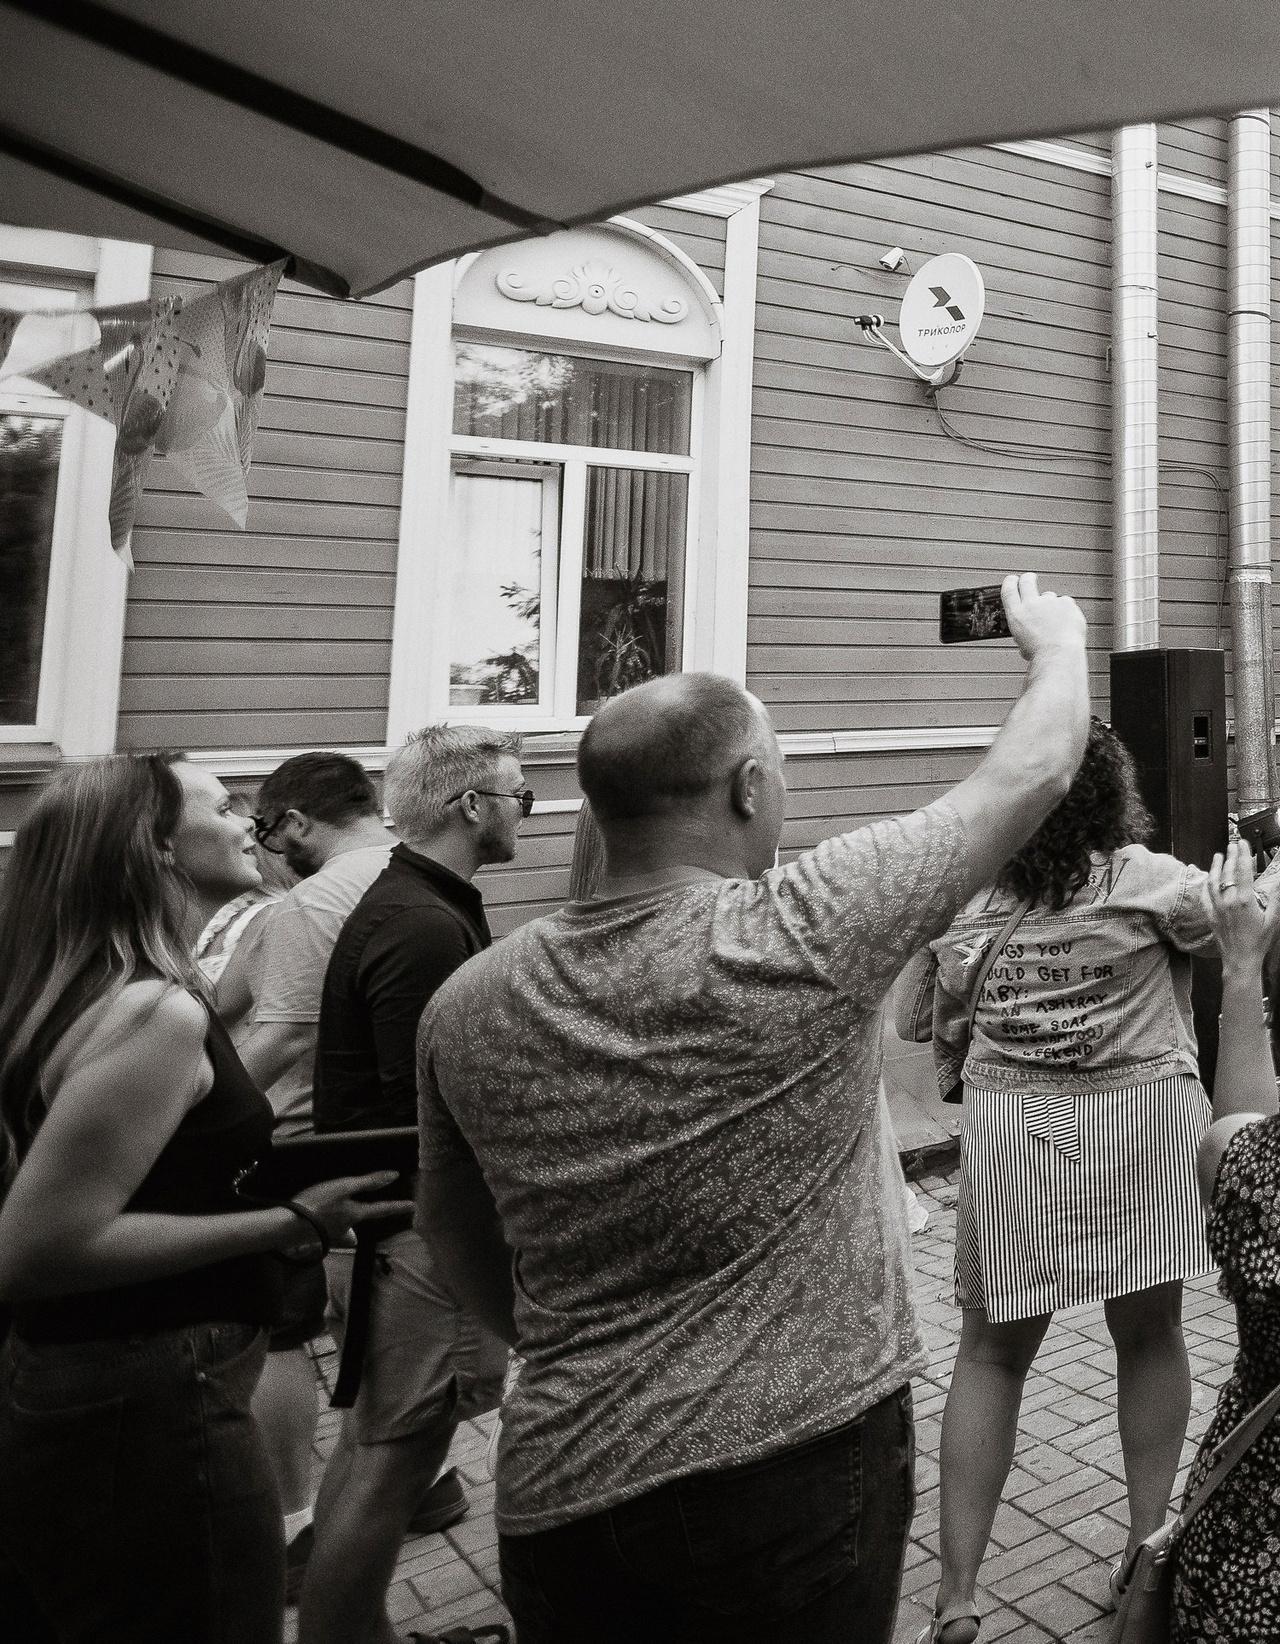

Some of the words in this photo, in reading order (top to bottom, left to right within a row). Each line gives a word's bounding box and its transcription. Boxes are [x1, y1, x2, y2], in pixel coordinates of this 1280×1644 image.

[918, 324, 966, 337] ТРИКОЛОР
[1036, 941, 1072, 958] YOU
[1037, 965, 1071, 982] GET
[1081, 964, 1114, 980] FOR
[1036, 993, 1108, 1014] ASHTRAY
[1001, 1022, 1041, 1035] SOME
[1050, 1014, 1088, 1032] SOAP
